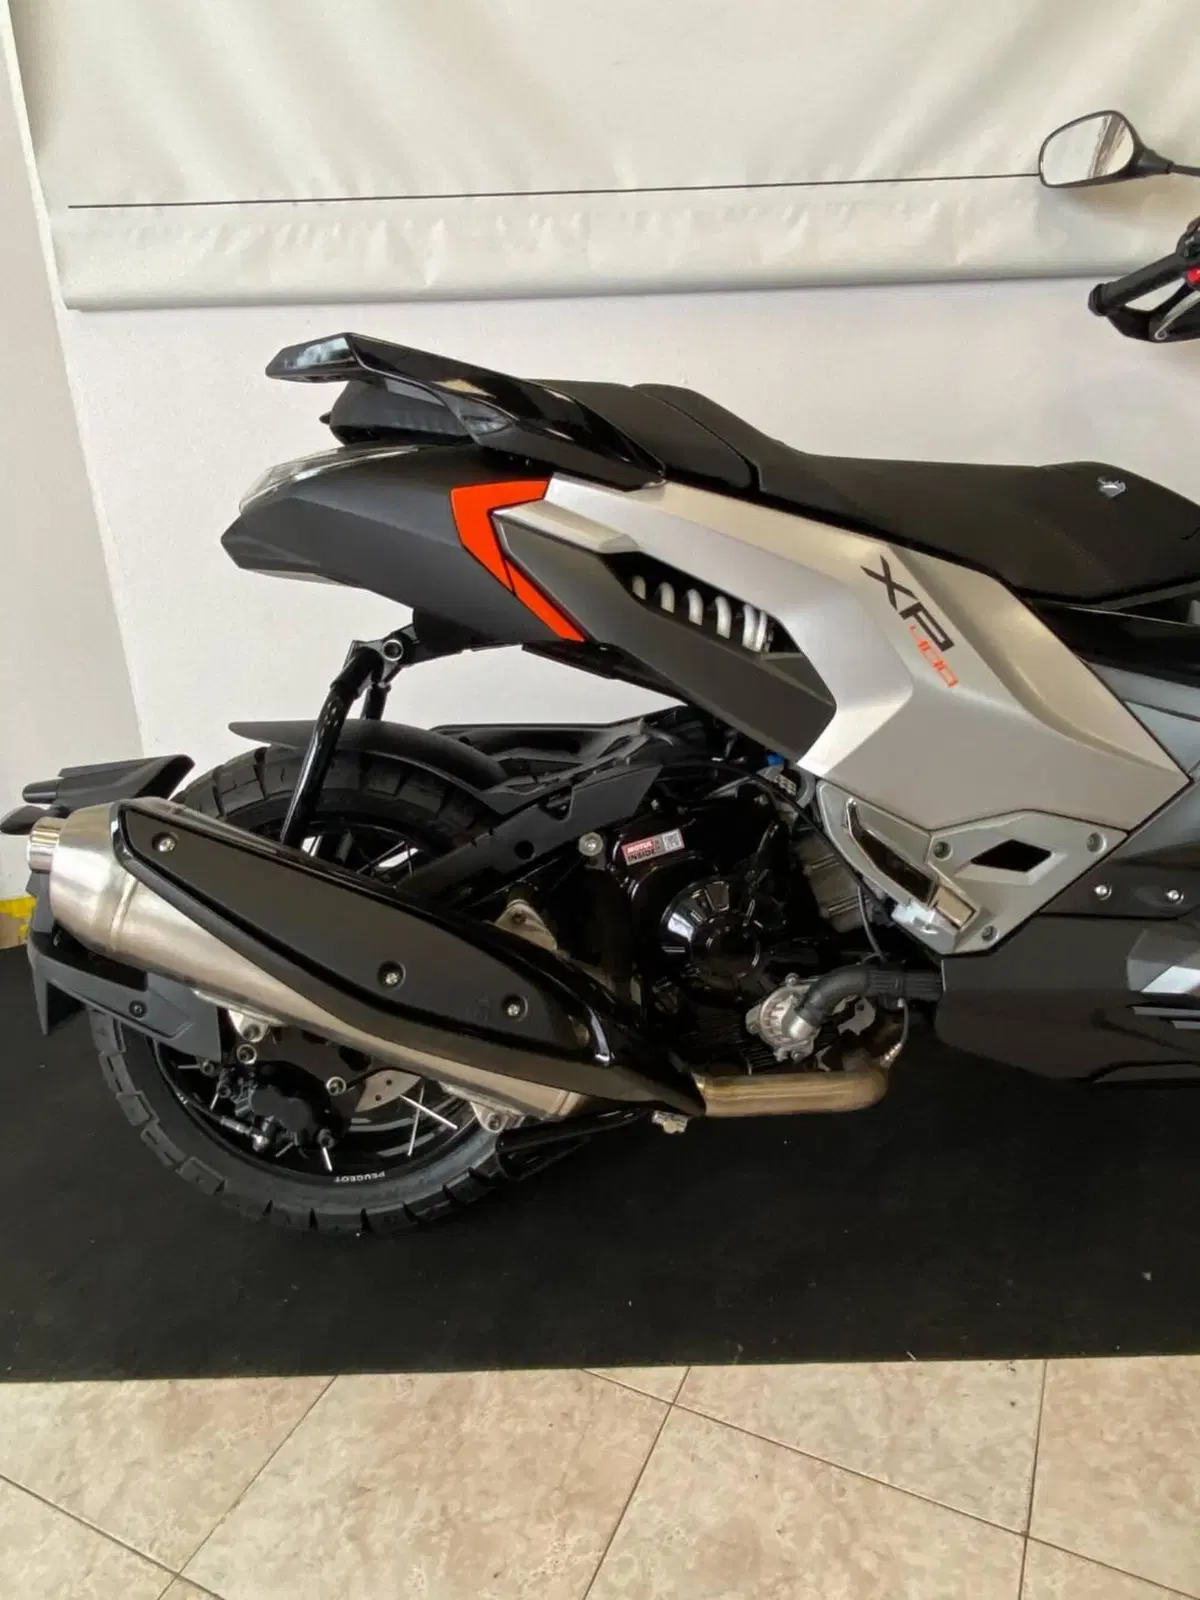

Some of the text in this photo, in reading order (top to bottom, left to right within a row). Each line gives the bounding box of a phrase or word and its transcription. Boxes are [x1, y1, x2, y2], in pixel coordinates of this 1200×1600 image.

[860, 554, 955, 652] XP
[627, 848, 656, 860] INSIDE
[334, 1171, 385, 1183] PEUGEOT
